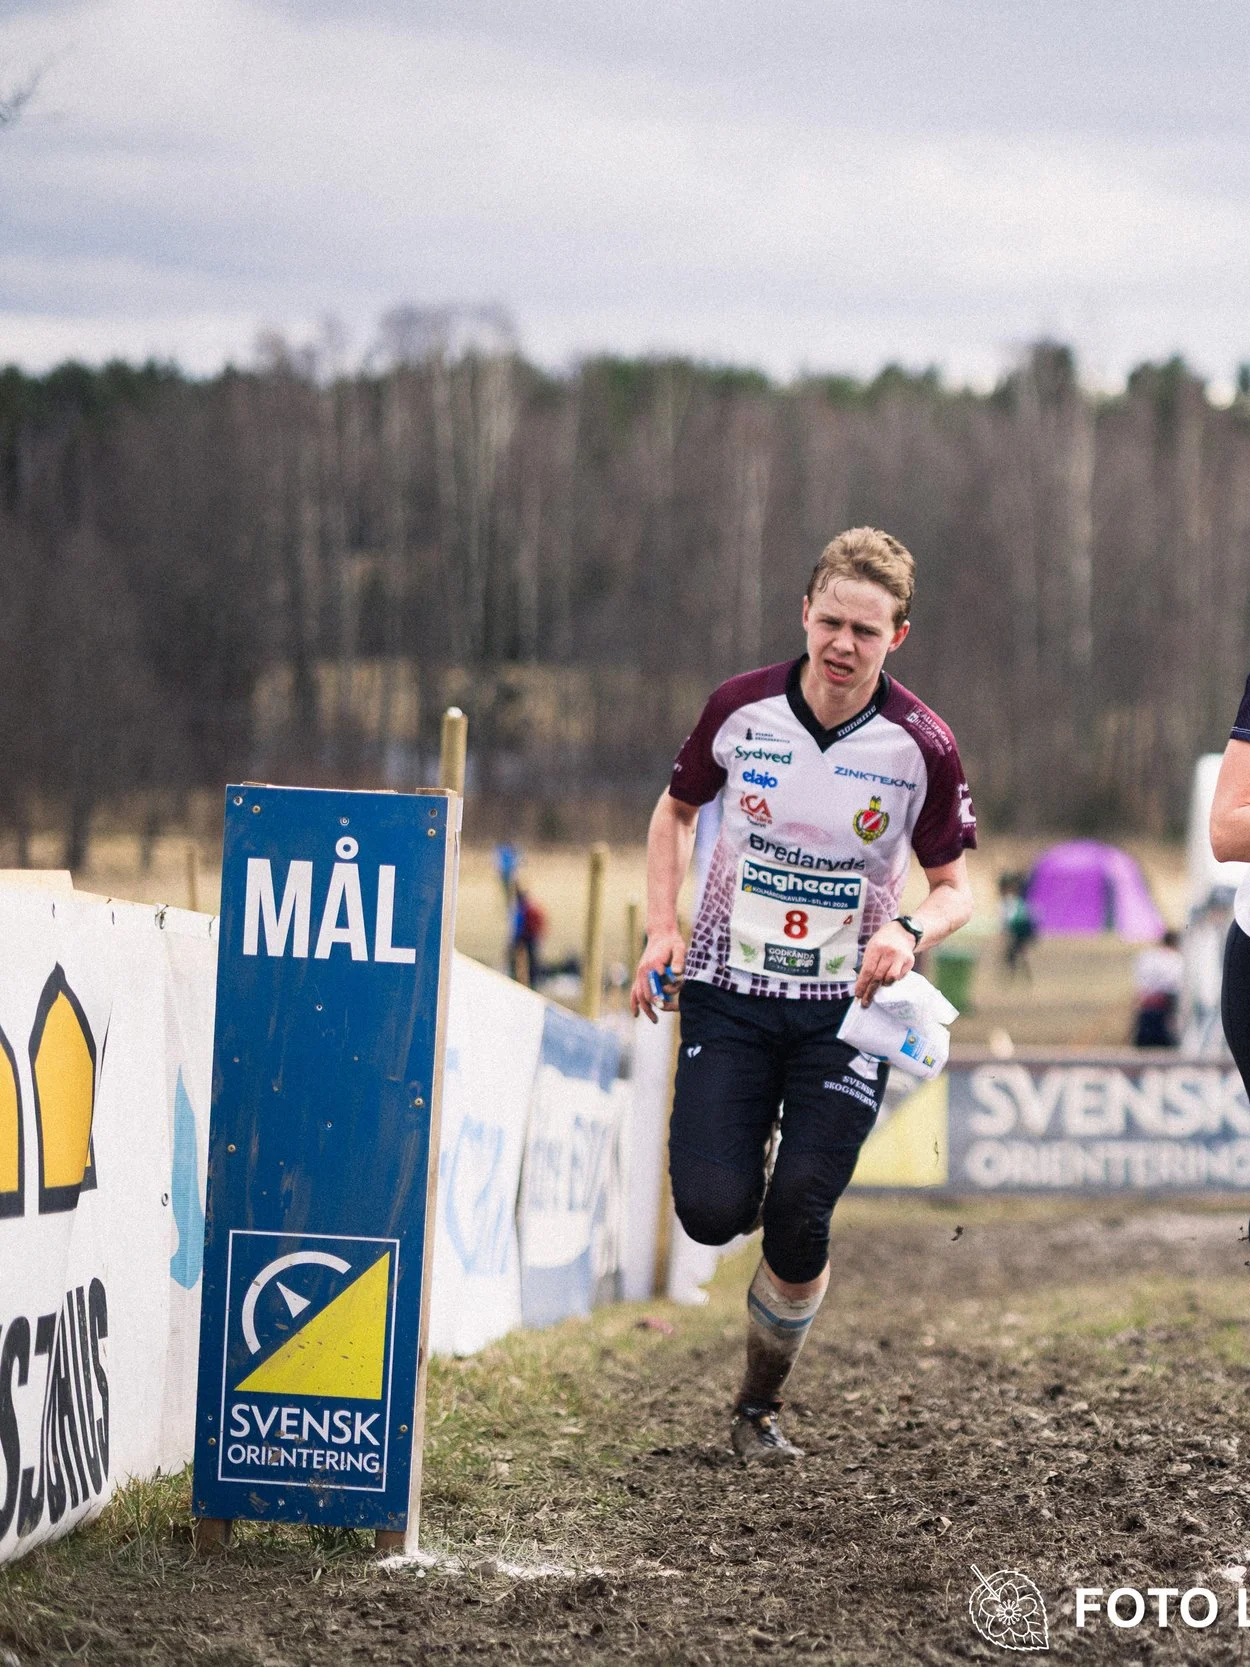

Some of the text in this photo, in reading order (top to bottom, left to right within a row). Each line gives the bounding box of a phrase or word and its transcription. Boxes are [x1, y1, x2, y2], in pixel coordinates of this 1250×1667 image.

[735, 745, 793, 765] Sydved
[742, 768, 778, 789] elajo
[740, 791, 773, 819] ICA
[750, 832, 866, 872] Bredaryds
[743, 861, 860, 897] bagheera
[243, 836, 416, 964] MÅL
[783, 909, 853, 940] 8 4
[842, 1075, 876, 1098] SVENSK
[229, 1403, 382, 1447] SVENSK
[227, 1444, 381, 1474] ORIENTERING
